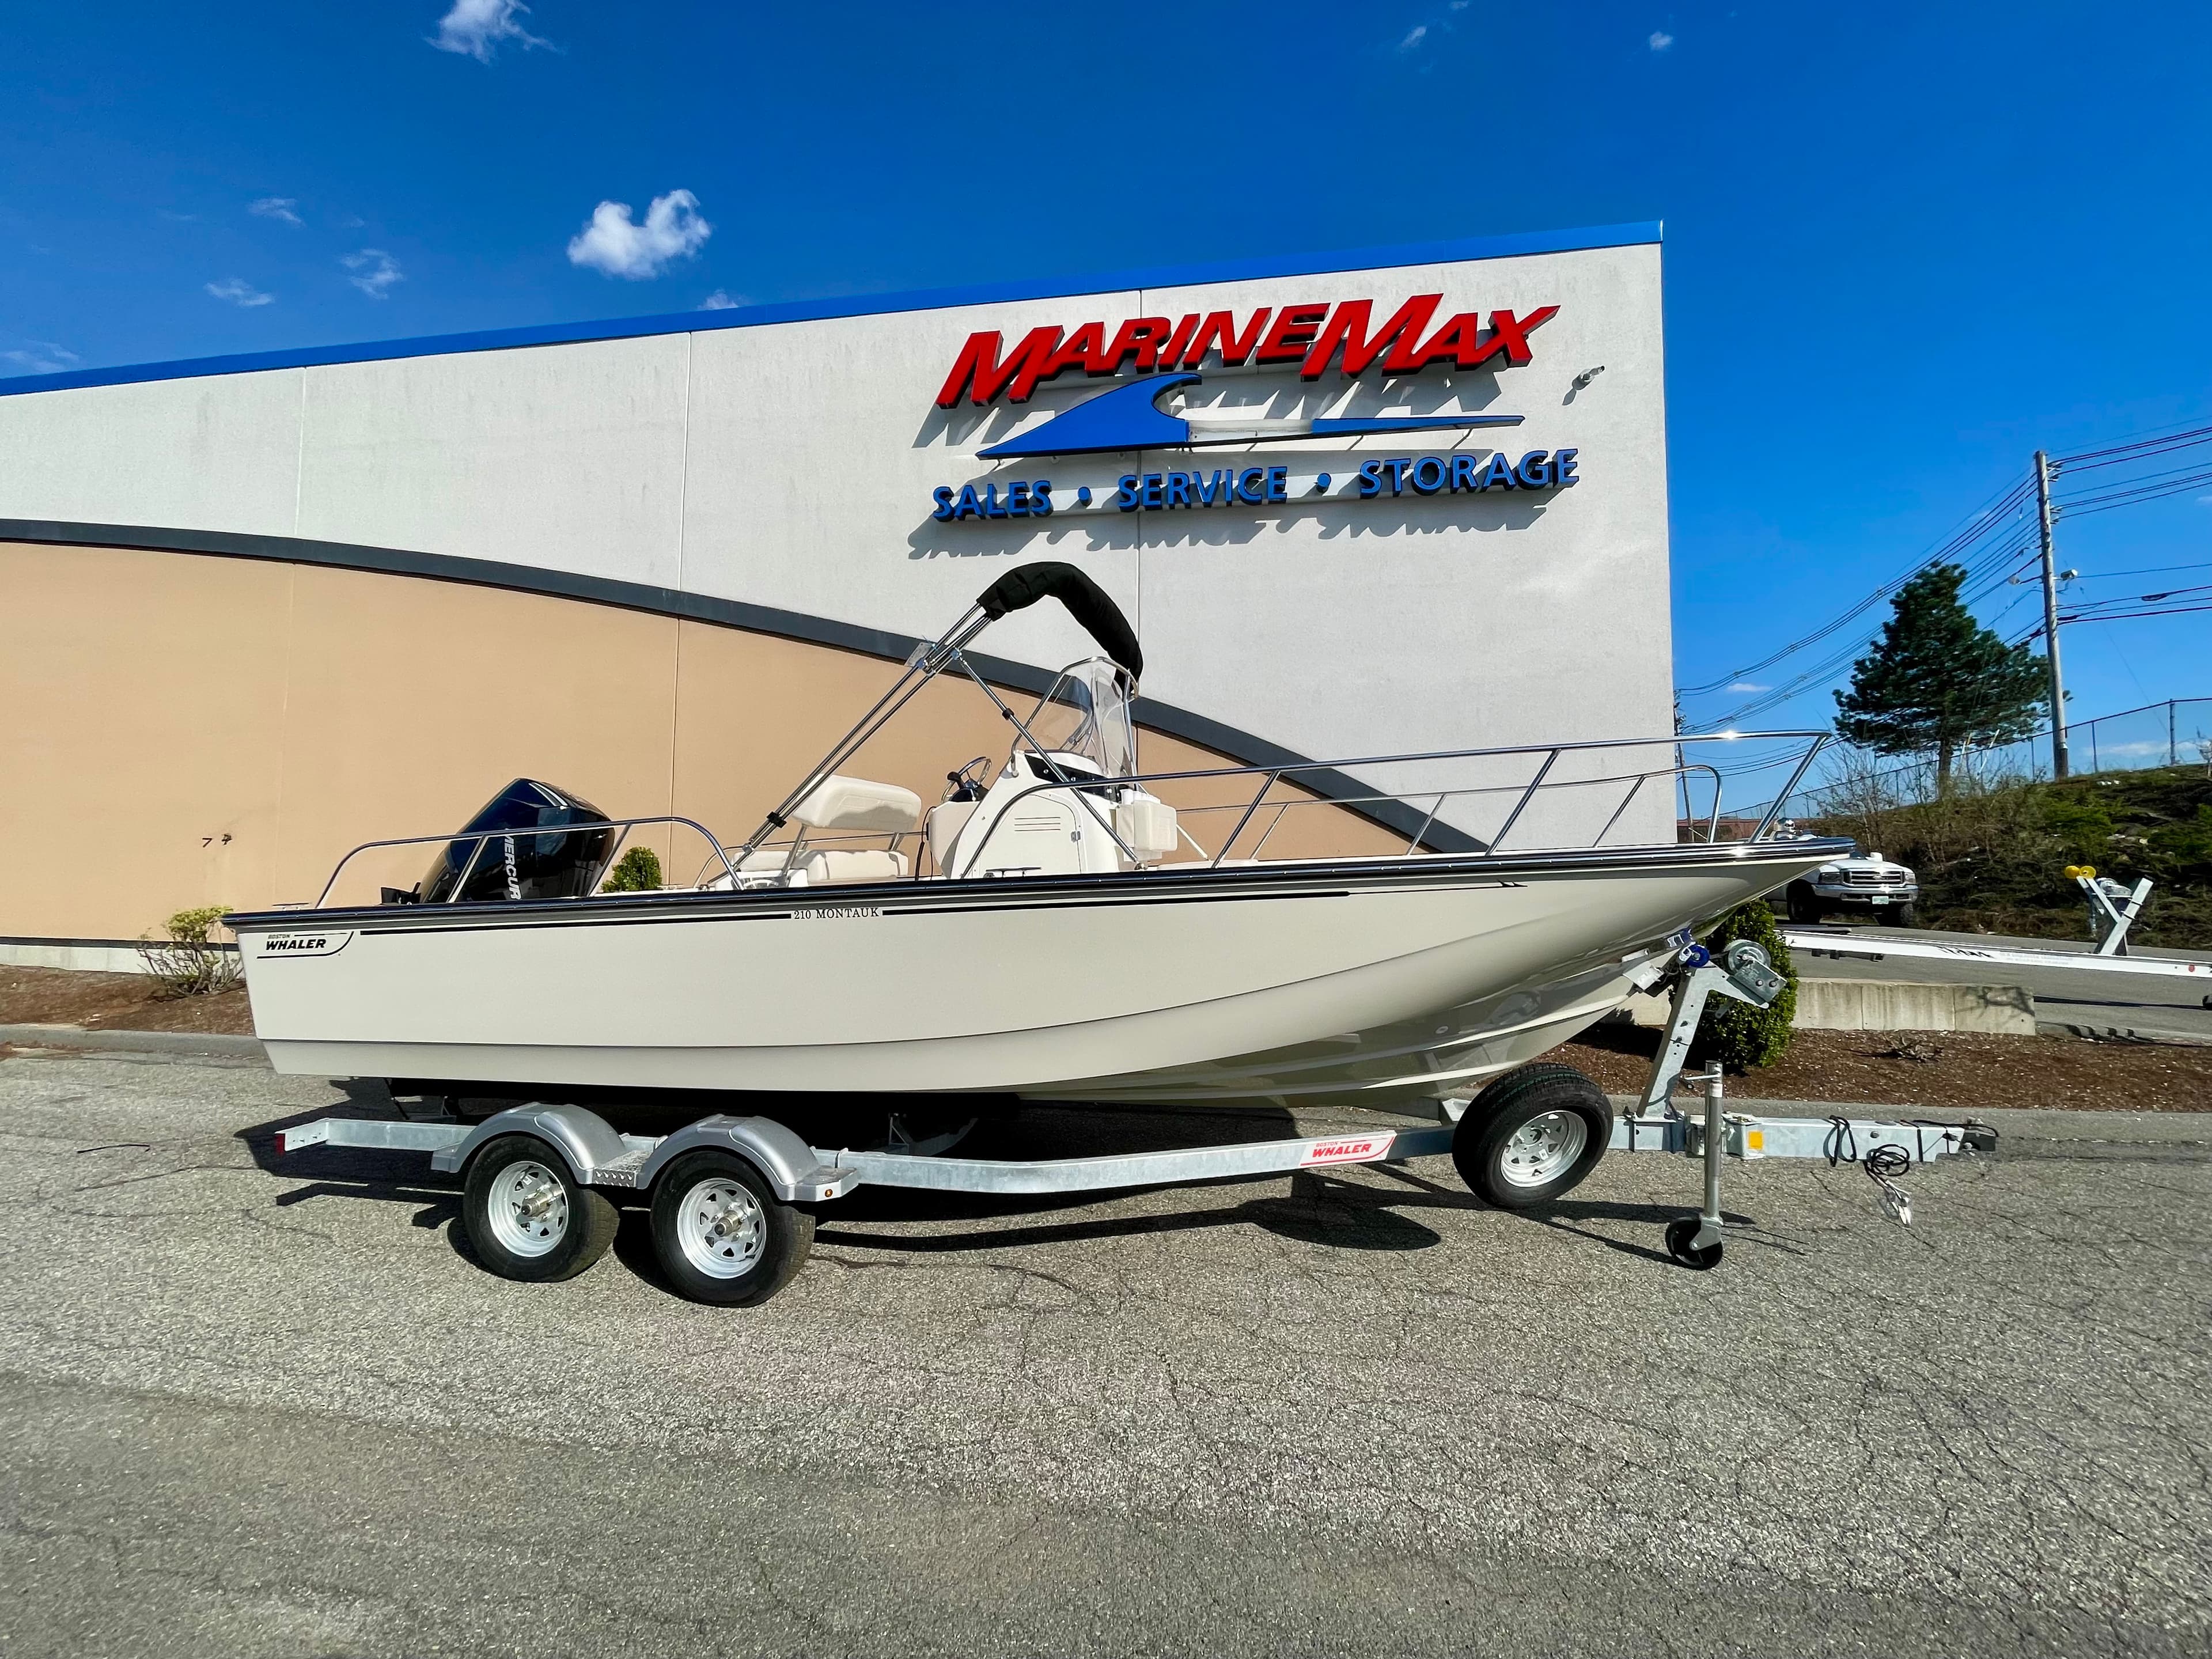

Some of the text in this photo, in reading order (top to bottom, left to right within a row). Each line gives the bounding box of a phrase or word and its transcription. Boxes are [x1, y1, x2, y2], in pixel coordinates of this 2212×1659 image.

[933, 448, 1580, 521] SALES SERVICE STORAGE
[794, 907, 879, 919] 210 MONTAUK
[266, 939, 326, 950] WHALER
[1312, 1143, 1371, 1157] WHALER
